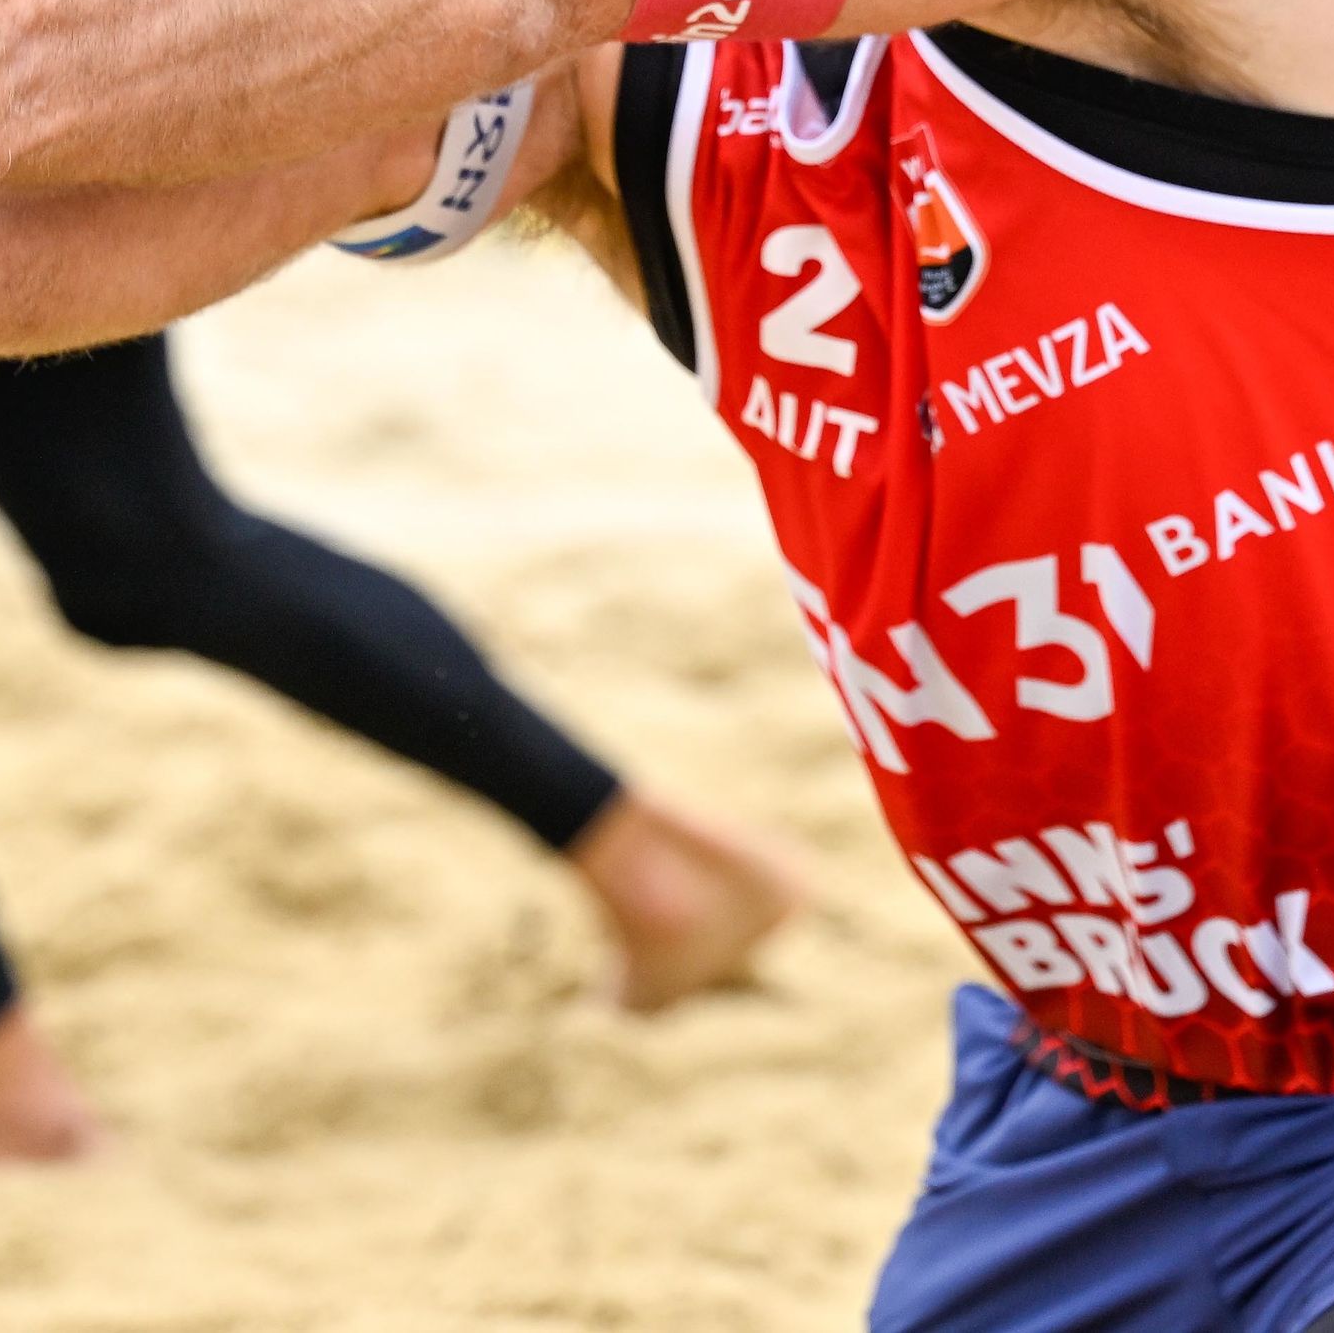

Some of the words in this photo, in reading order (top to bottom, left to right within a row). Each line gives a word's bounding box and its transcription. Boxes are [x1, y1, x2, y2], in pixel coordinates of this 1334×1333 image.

[760, 223, 863, 377] 2
[741, 375, 880, 479] AUT
[940, 301, 1151, 435] MEVZA
